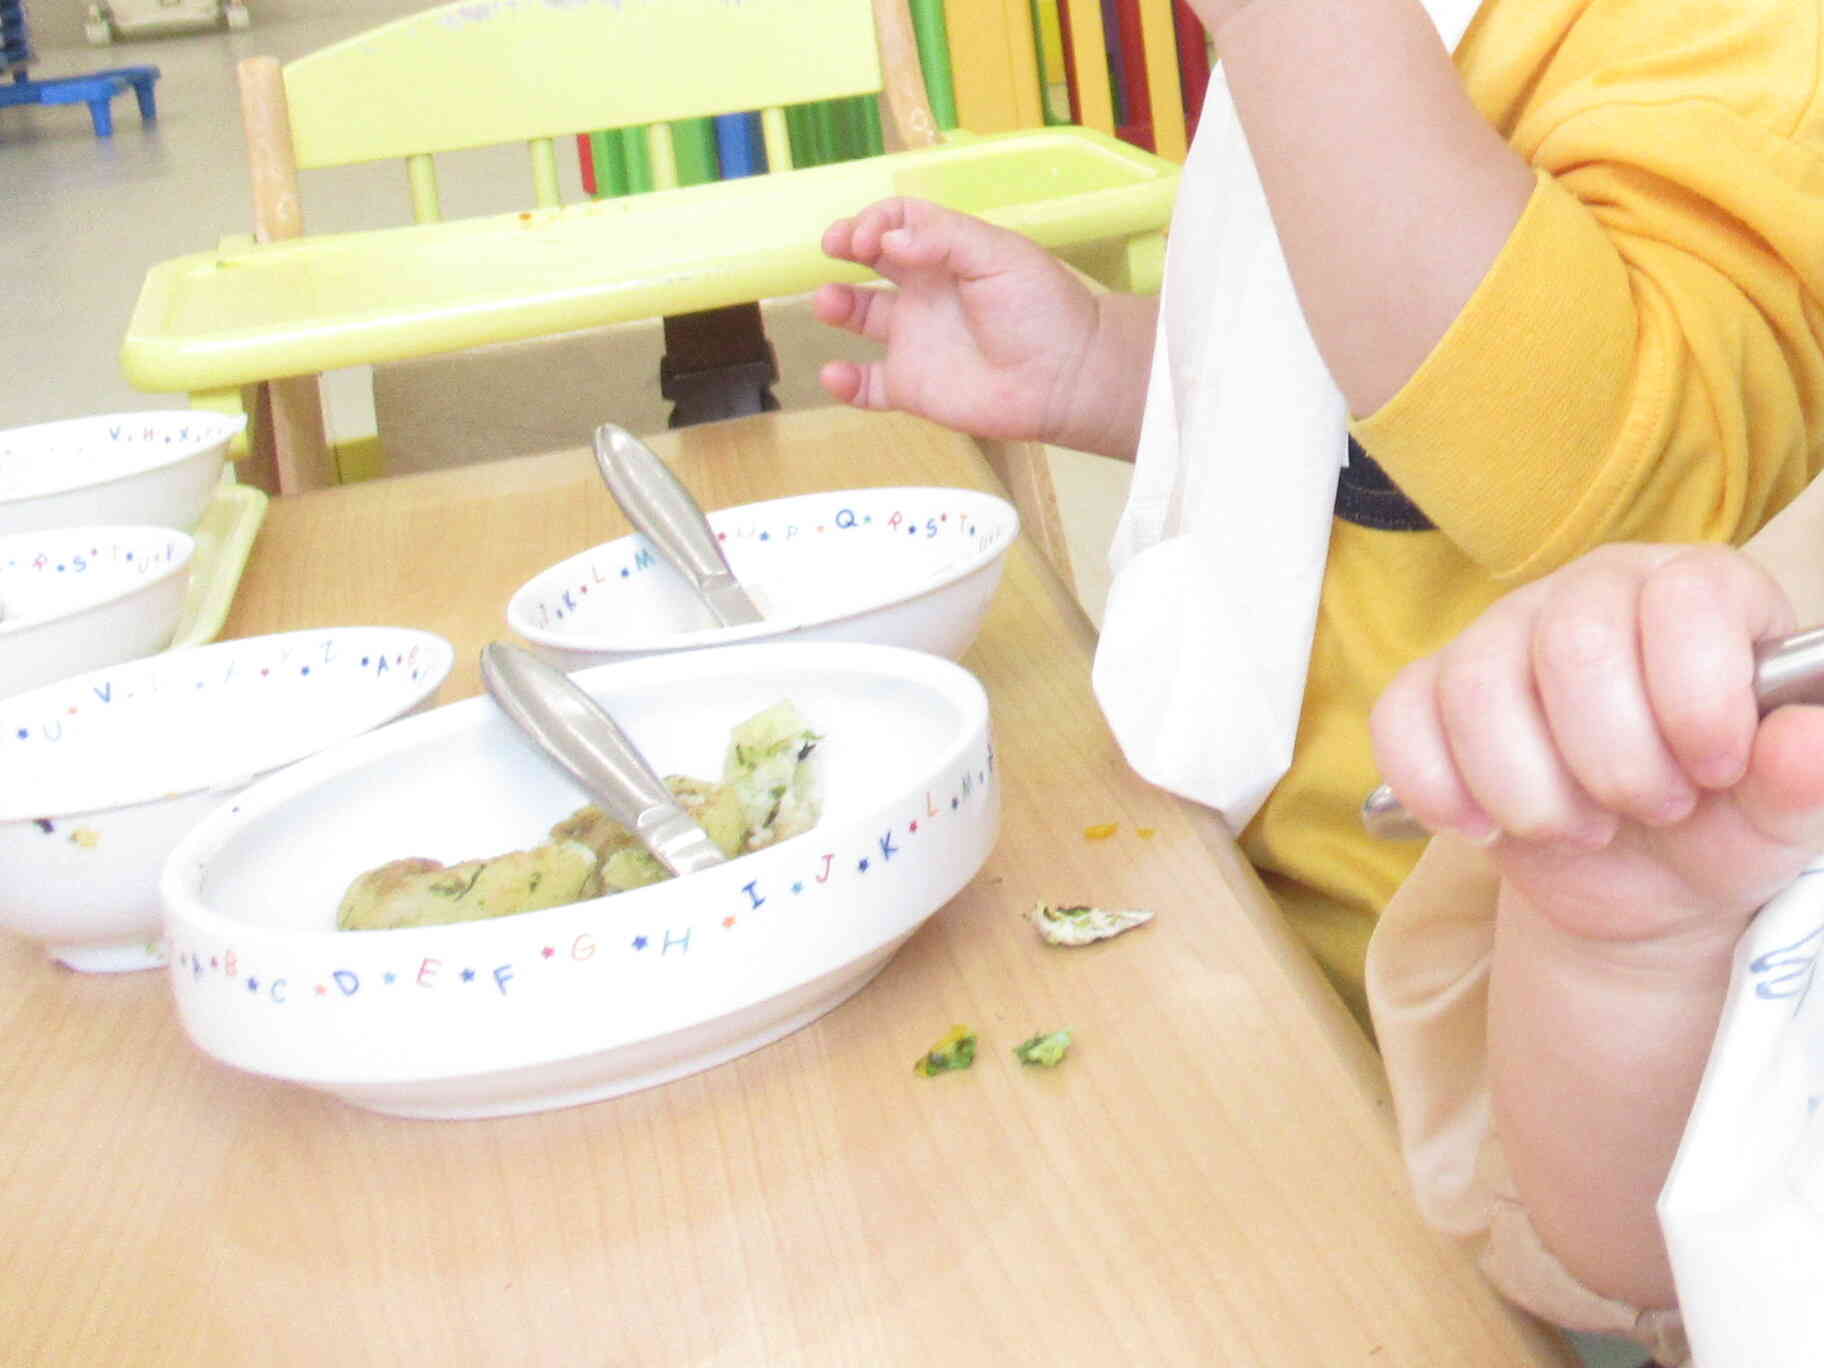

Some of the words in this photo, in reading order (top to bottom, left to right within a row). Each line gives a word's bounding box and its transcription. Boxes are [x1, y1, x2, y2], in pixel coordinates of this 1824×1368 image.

[835, 508, 859, 530] Q
[925, 517, 938, 540] S
[72, 553, 88, 574] S
[91, 679, 112, 704] V
[270, 977, 288, 1004] C
[331, 968, 361, 998] D
[416, 957, 442, 988] E
[492, 963, 514, 997] F
[571, 932, 595, 961] G
[660, 928, 692, 957] H
[740, 879, 767, 911] I
[815, 852, 834, 884] J
[879, 828, 900, 863] K
[924, 790, 941, 818] L
